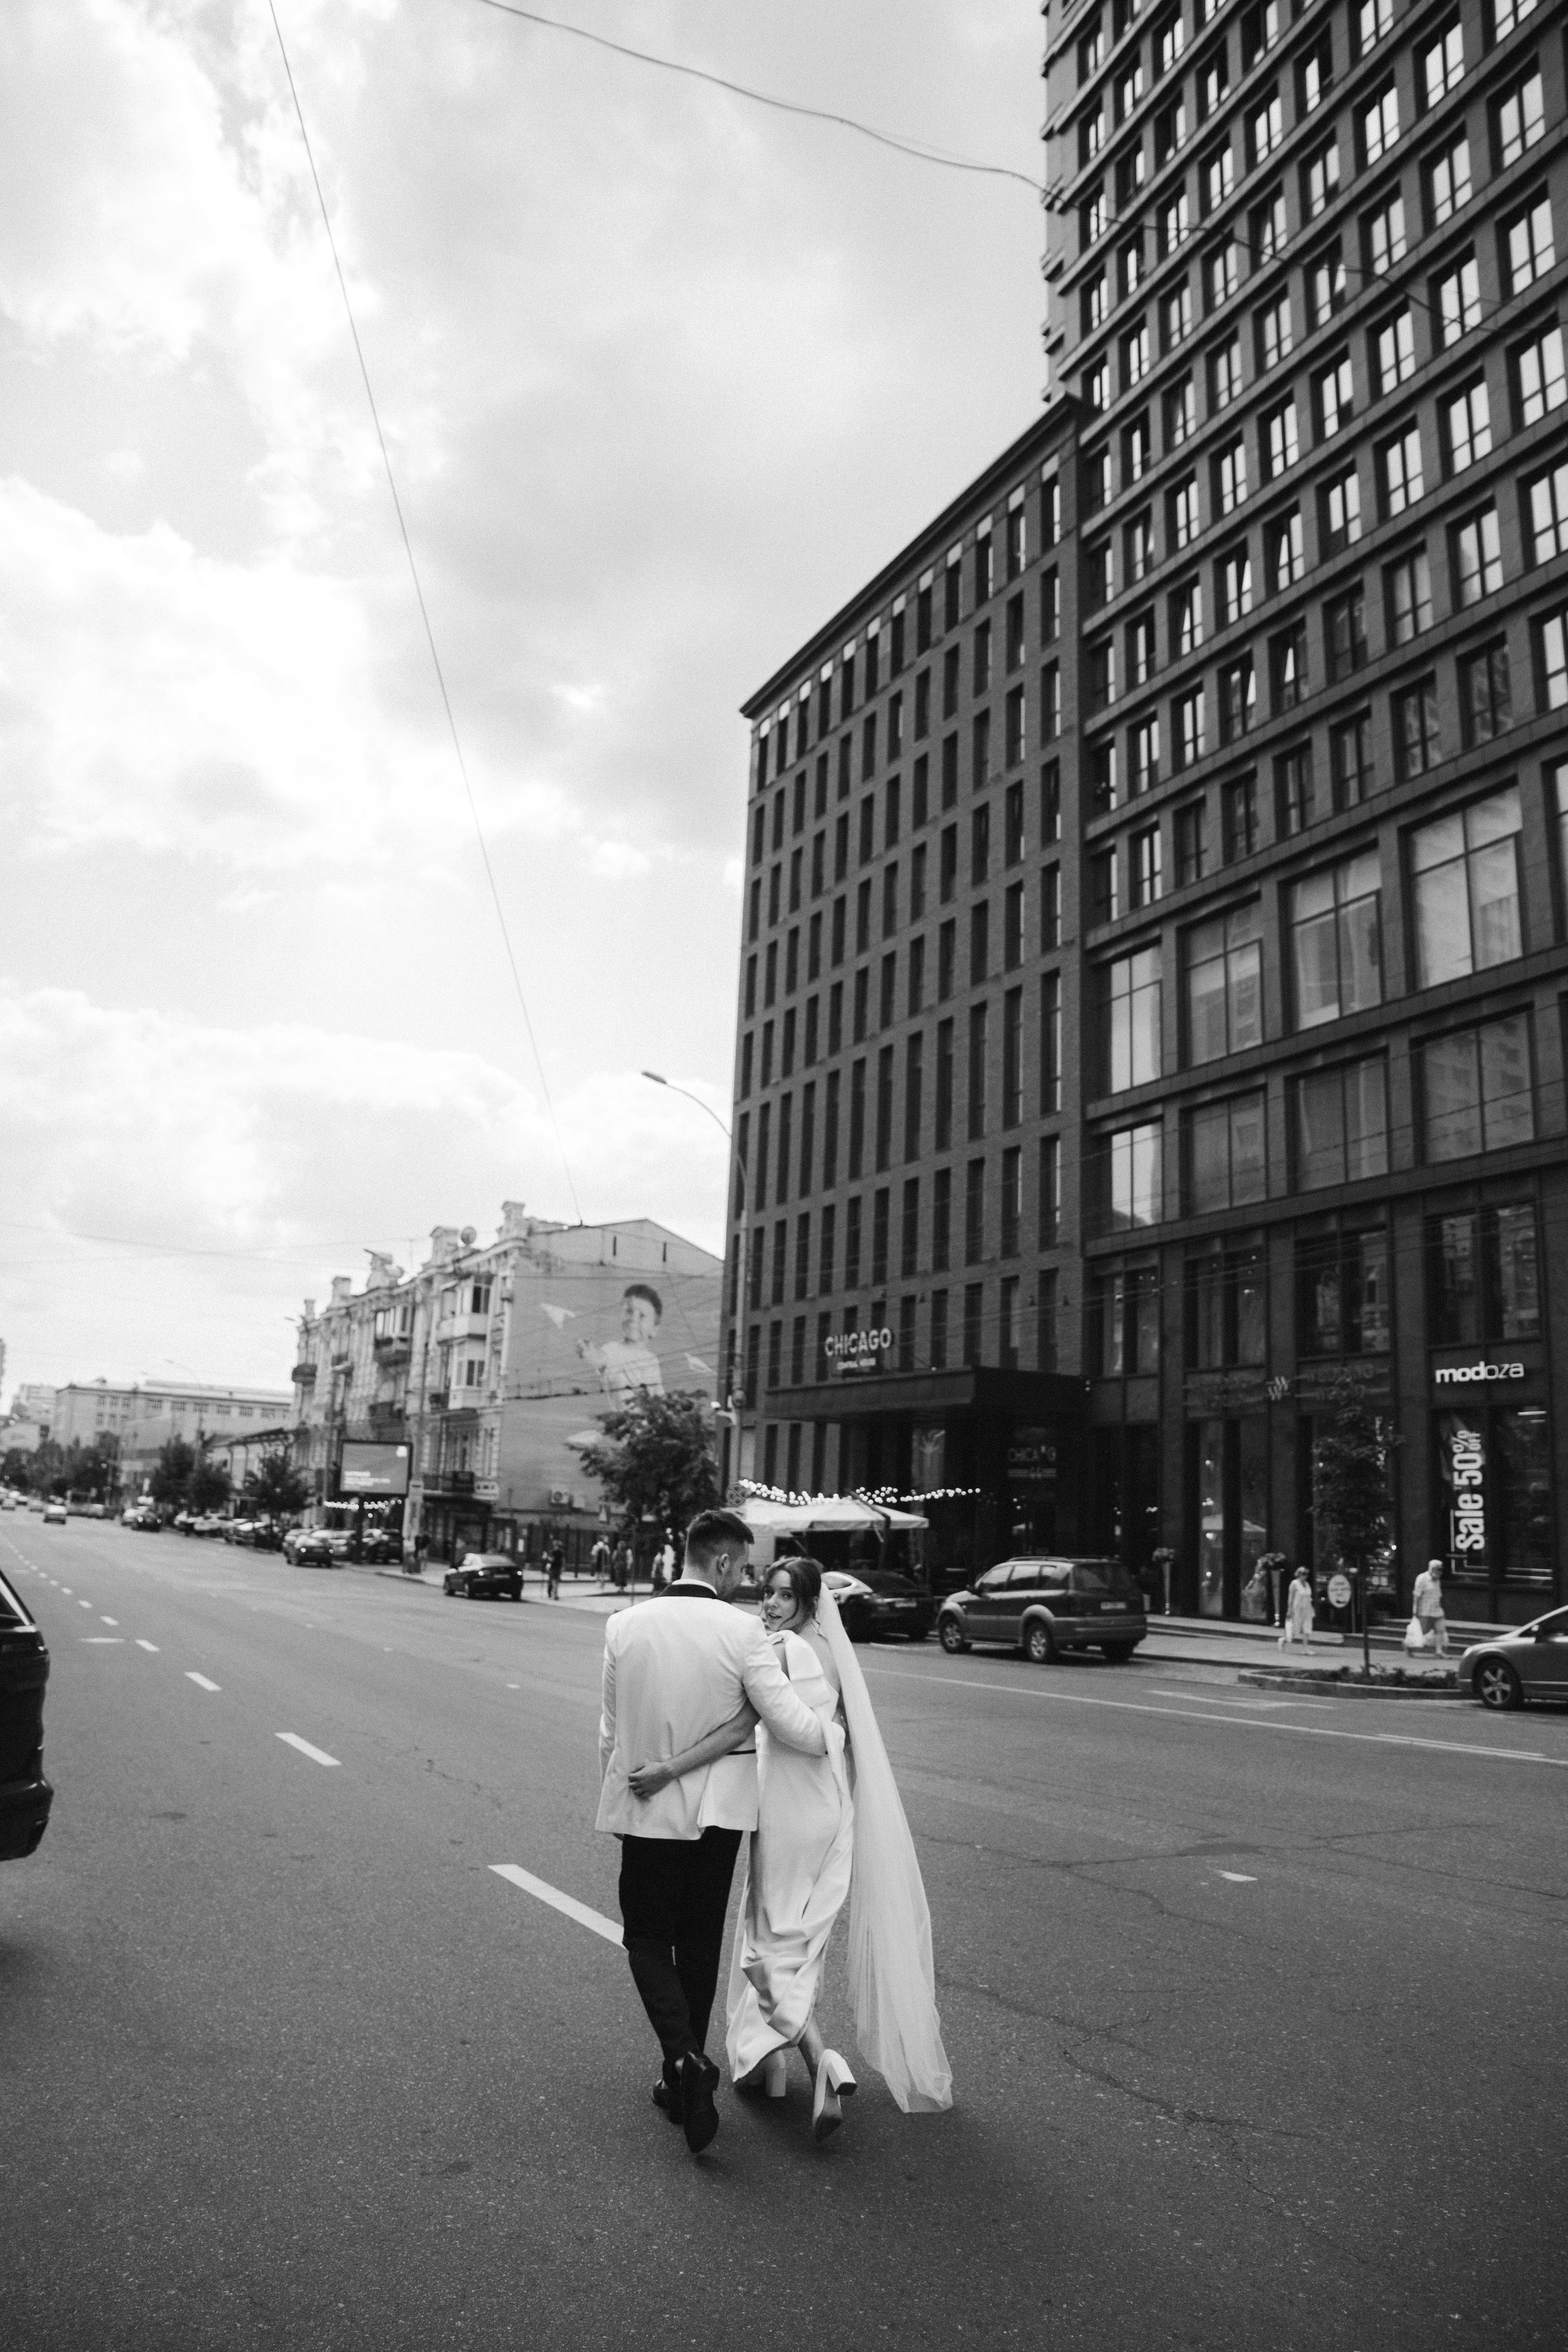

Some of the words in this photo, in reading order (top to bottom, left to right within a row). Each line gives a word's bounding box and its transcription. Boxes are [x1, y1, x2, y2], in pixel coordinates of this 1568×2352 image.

[824, 1327, 891, 1357] CHICAGO
[1435, 1361, 1525, 1383] modoza
[1007, 1446, 1057, 1462] CHICAO
[1452, 1430, 1483, 1485] 50%
[1455, 1493, 1485, 1550] Sale
